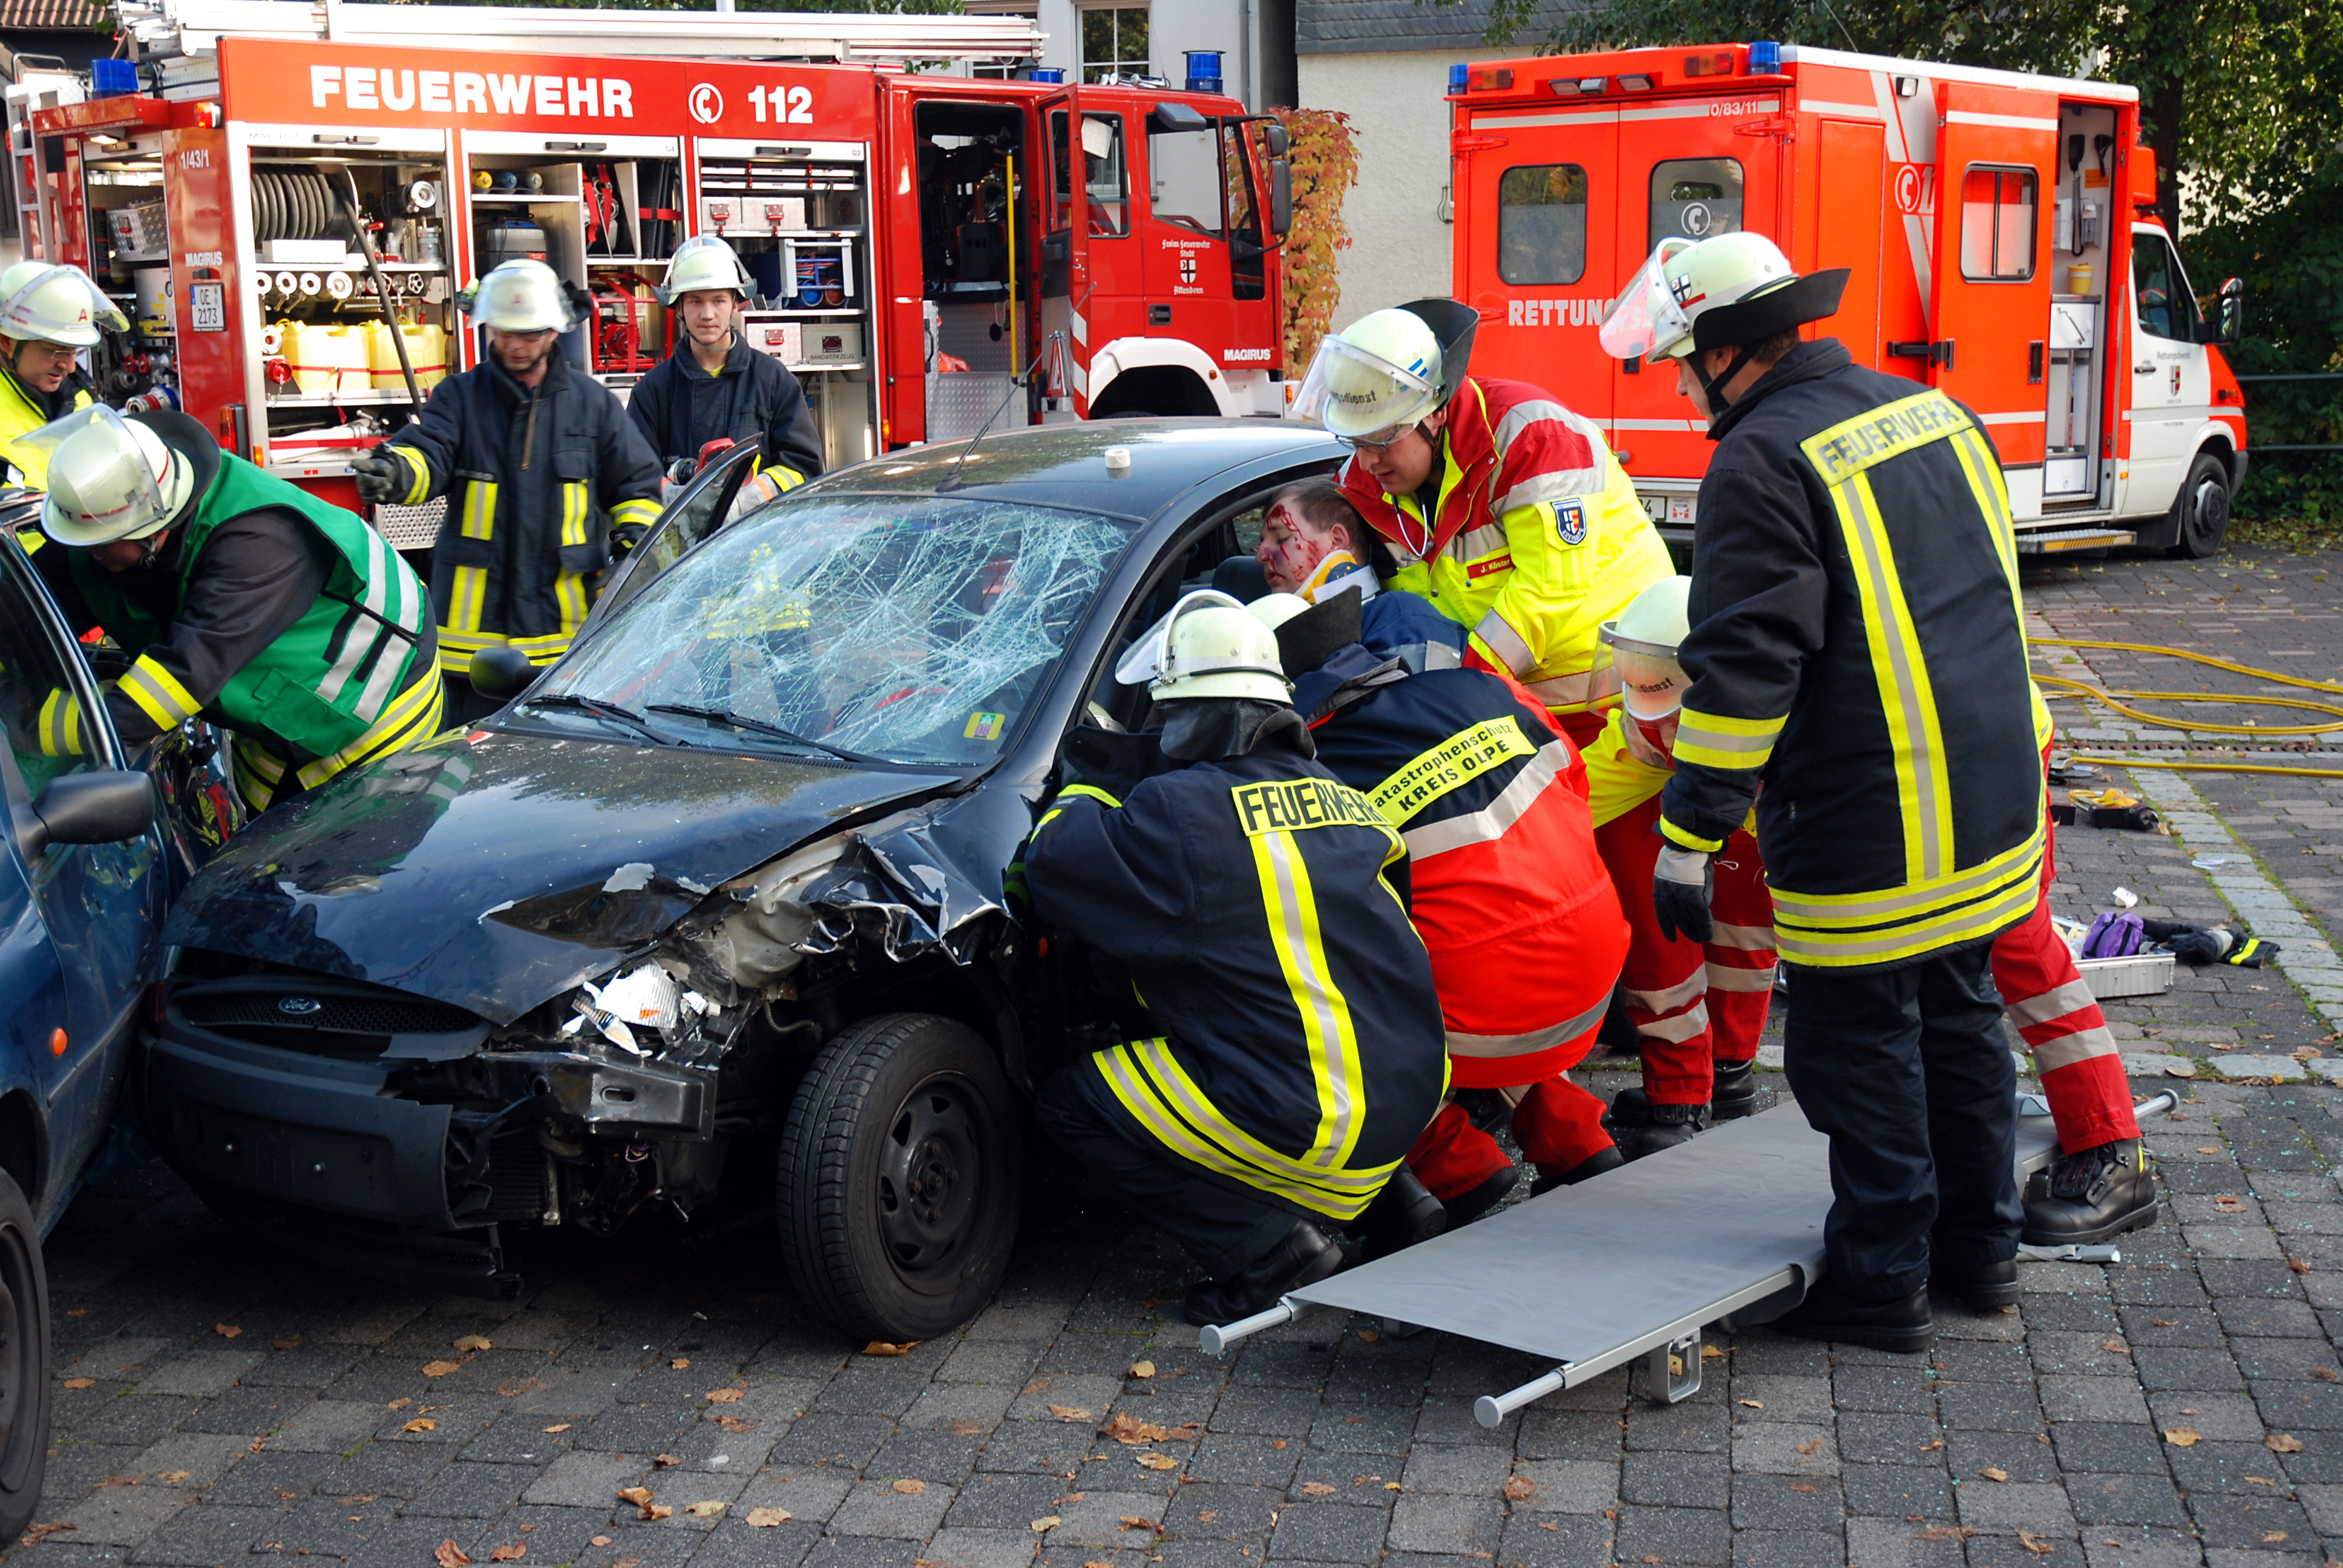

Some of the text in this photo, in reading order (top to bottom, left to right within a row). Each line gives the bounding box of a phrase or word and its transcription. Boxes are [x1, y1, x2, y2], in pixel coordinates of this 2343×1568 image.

[310, 65, 813, 123] FEUERWEHR 112
[1711, 100, 1757, 117] 0/83/11
[180, 149, 209, 169] 1/43/1
[185, 250, 223, 267] MAGIRUS
[200, 289, 211, 305] OE
[78, 309, 88, 322] A
[198, 308, 217, 324] 2173
[1224, 348, 1271, 361] MAGIRUS
[1816, 400, 1960, 474] FEUERWEHR
[1481, 559, 1510, 573] J. Köster
[1375, 722, 1513, 808] atastrophenschutz
[1398, 740, 1510, 812] KREIS OLPE
[1239, 782, 1388, 831] FEUERWEHR
[285, 998, 310, 1010] Ford
